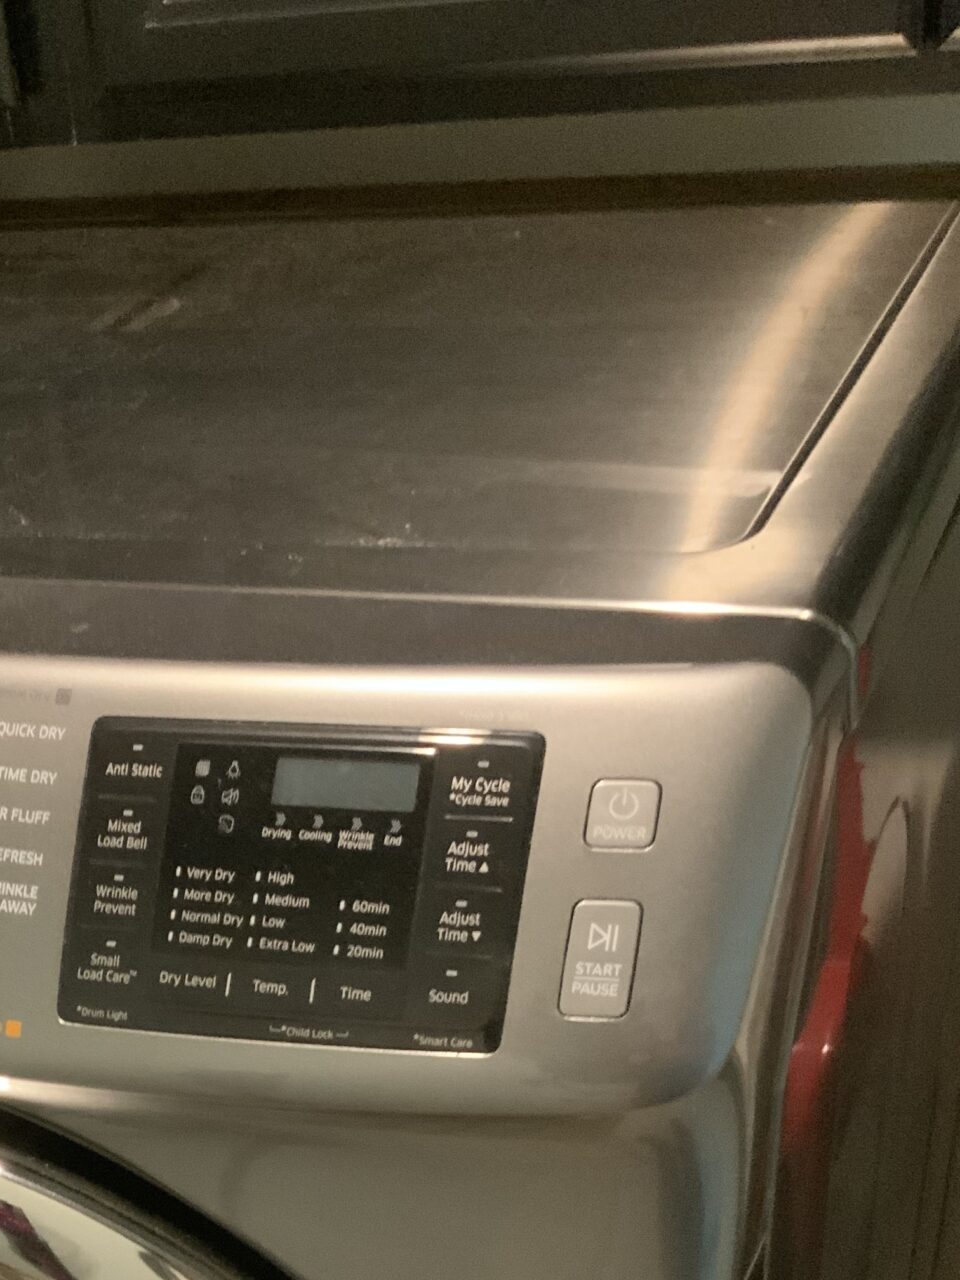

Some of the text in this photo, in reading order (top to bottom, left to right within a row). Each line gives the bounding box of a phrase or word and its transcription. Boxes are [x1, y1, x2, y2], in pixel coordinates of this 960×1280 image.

[39, 725, 66, 741] DRY
[30, 769, 58, 785] DRY
[105, 762, 163, 779] Anti Static
[451, 776, 511, 793] My Cycle
[485, 795, 509, 807] Save
[10, 808, 51, 824] FLUFF
[107, 819, 142, 834] Mixed
[593, 825, 647, 840] POWER
[97, 834, 148, 850] Load Bell
[261, 826, 332, 844] Drying Cooling
[339, 830, 375, 841] Wrinkle
[384, 834, 402, 847] End
[337, 839, 373, 850] Prevent
[448, 841, 490, 859] Adjust
[445, 857, 476, 873] Time
[187, 867, 236, 883] Very Dry
[268, 871, 295, 886] High
[95, 884, 139, 900] Wrinkle
[184, 888, 235, 905] More Dry
[93, 900, 137, 917] Prevent
[264, 893, 310, 908] Medium
[352, 900, 390, 915] 60min
[181, 909, 244, 928] Normal Dry
[262, 916, 286, 929] Low
[439, 911, 481, 928] Adjust
[349, 922, 387, 937] 40min
[437, 927, 468, 943] Time
[178, 931, 233, 948] Damp Dry
[259, 937, 316, 953] Extra Low
[347, 944, 384, 960] 20min
[90, 953, 120, 968] Small
[77, 967, 104, 982] Load
[575, 961, 623, 977] START
[159, 970, 218, 988] Dry Level
[253, 979, 289, 996] Temp.
[340, 986, 372, 1001] Time
[572, 981, 619, 997] PAUSE
[429, 989, 470, 1005] Sound
[106, 1009, 128, 1022] Light
[312, 1027, 334, 1040] Lock
[450, 1035, 473, 1049] Care
